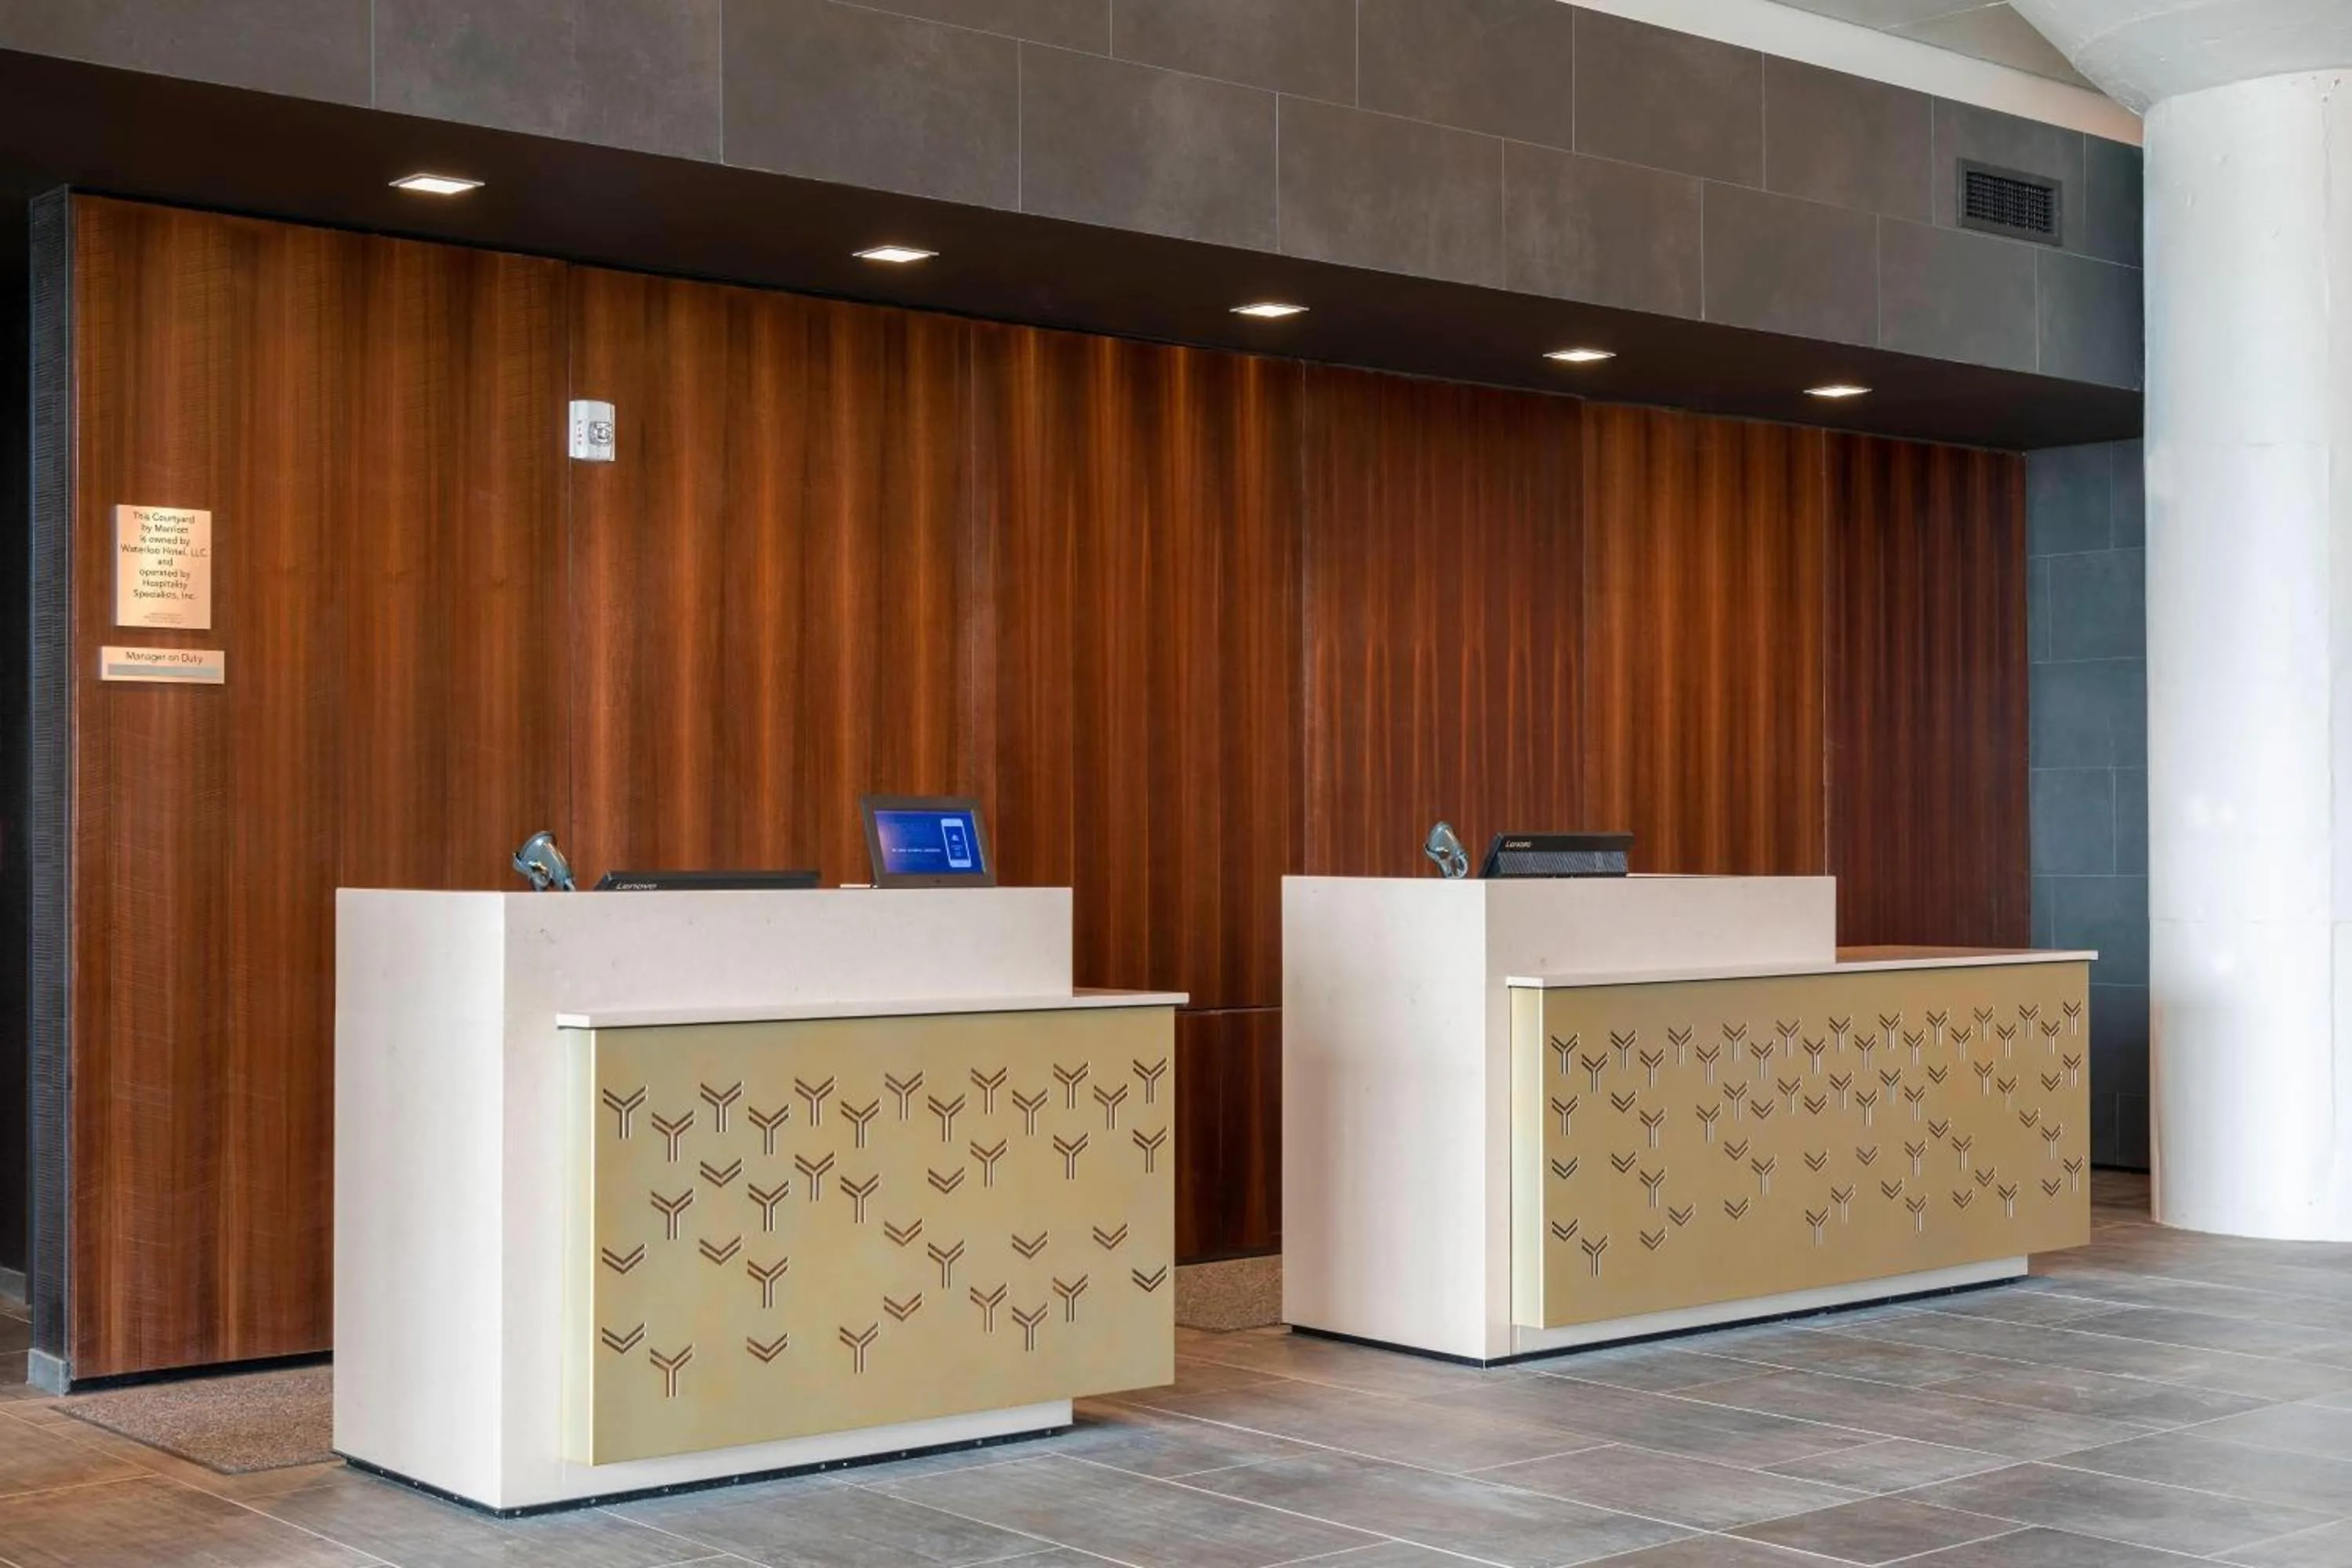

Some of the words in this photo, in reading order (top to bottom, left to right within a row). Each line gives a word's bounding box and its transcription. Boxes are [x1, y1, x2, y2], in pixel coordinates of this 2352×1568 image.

[152, 513, 195, 524] Courtyard
[142, 524, 152, 533] by
[154, 524, 188, 534] Marriott
[180, 537, 191, 546] by
[121, 544, 160, 554] Waterloo
[140, 568, 177, 578] operated
[180, 569, 191, 579] by
[143, 579, 187, 590] Hospitality
[125, 652, 166, 662] Manager
[181, 653, 203, 665] Duty
